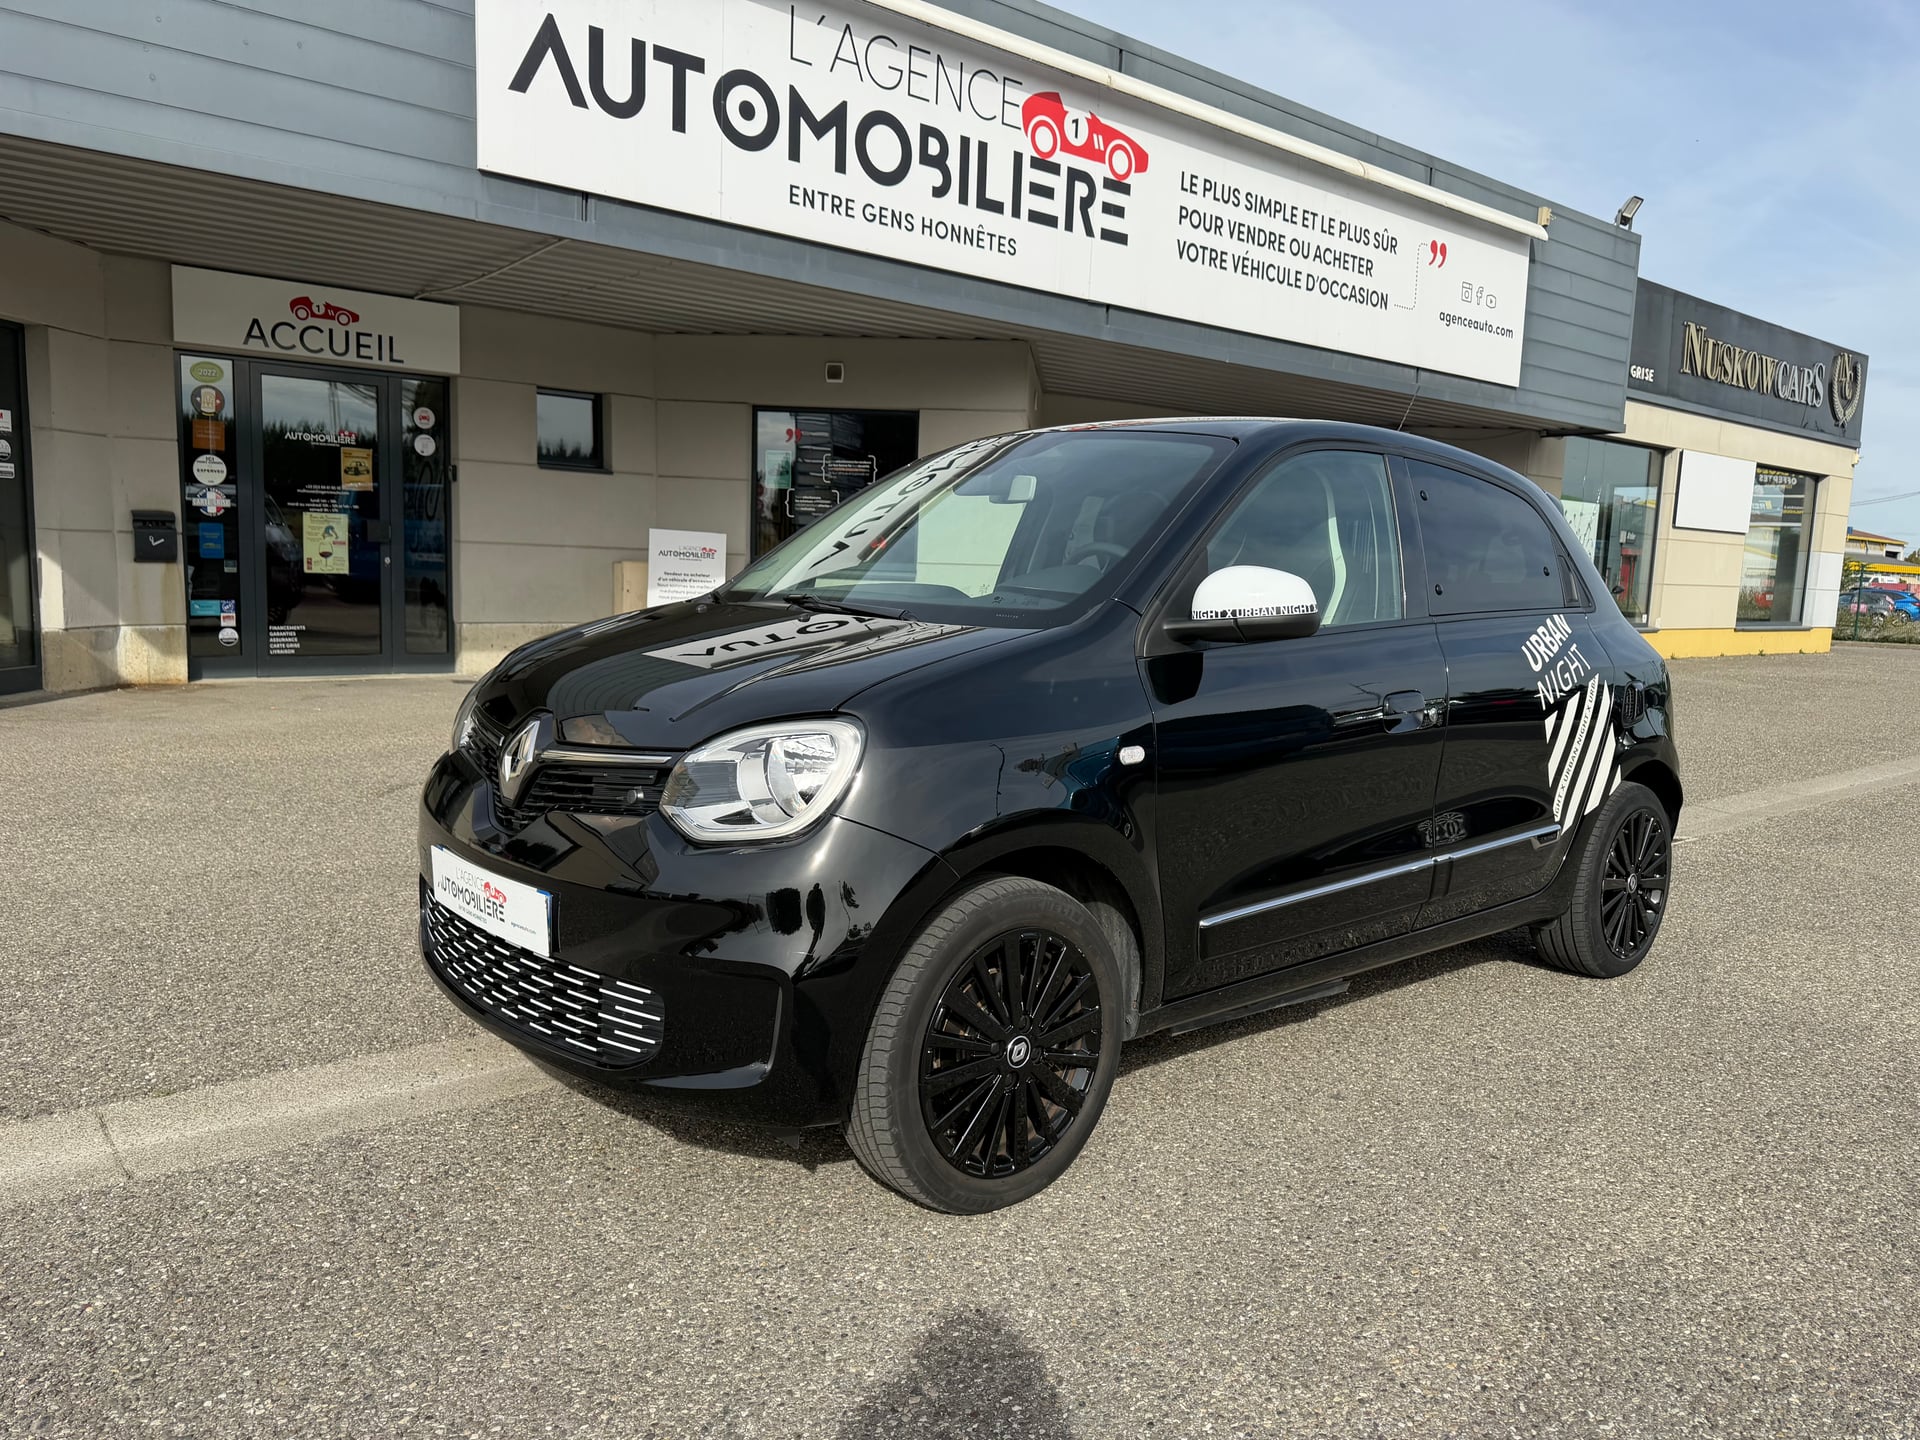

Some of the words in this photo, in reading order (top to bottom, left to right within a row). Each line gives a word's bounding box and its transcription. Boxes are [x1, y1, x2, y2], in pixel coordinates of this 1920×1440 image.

[789, 184, 855, 221] ENTRE
[862, 202, 915, 234] GENS
[921, 210, 1018, 257] HONNÊTES
[1180, 170, 1199, 196] LE
[1202, 176, 1241, 208] PLUS
[1244, 191, 1298, 226] SIMPLE
[1301, 209, 1319, 230] ET
[1320, 214, 1335, 237] LE
[1339, 219, 1371, 247] PLUS
[1373, 228, 1398, 255] SÛR
[1176, 238, 1228, 272] VOTRE
[1231, 250, 1302, 289] VÉHICULE
[1178, 205, 1223, 238] POUR
[1227, 220, 1286, 252] VENDRE
[1289, 237, 1311, 260] OU
[1312, 242, 1374, 278] ACHETER
[242, 317, 405, 364] ACCUEIL
[1439, 309, 1514, 340] agenceauto.com
[1630, 365, 1655, 383] GRISE
[1236, 606, 1277, 618] URBAN
[1281, 604, 1312, 616] NIGHT
[1521, 614, 1572, 673] URBAN
[1537, 643, 1591, 711] NIGHT
